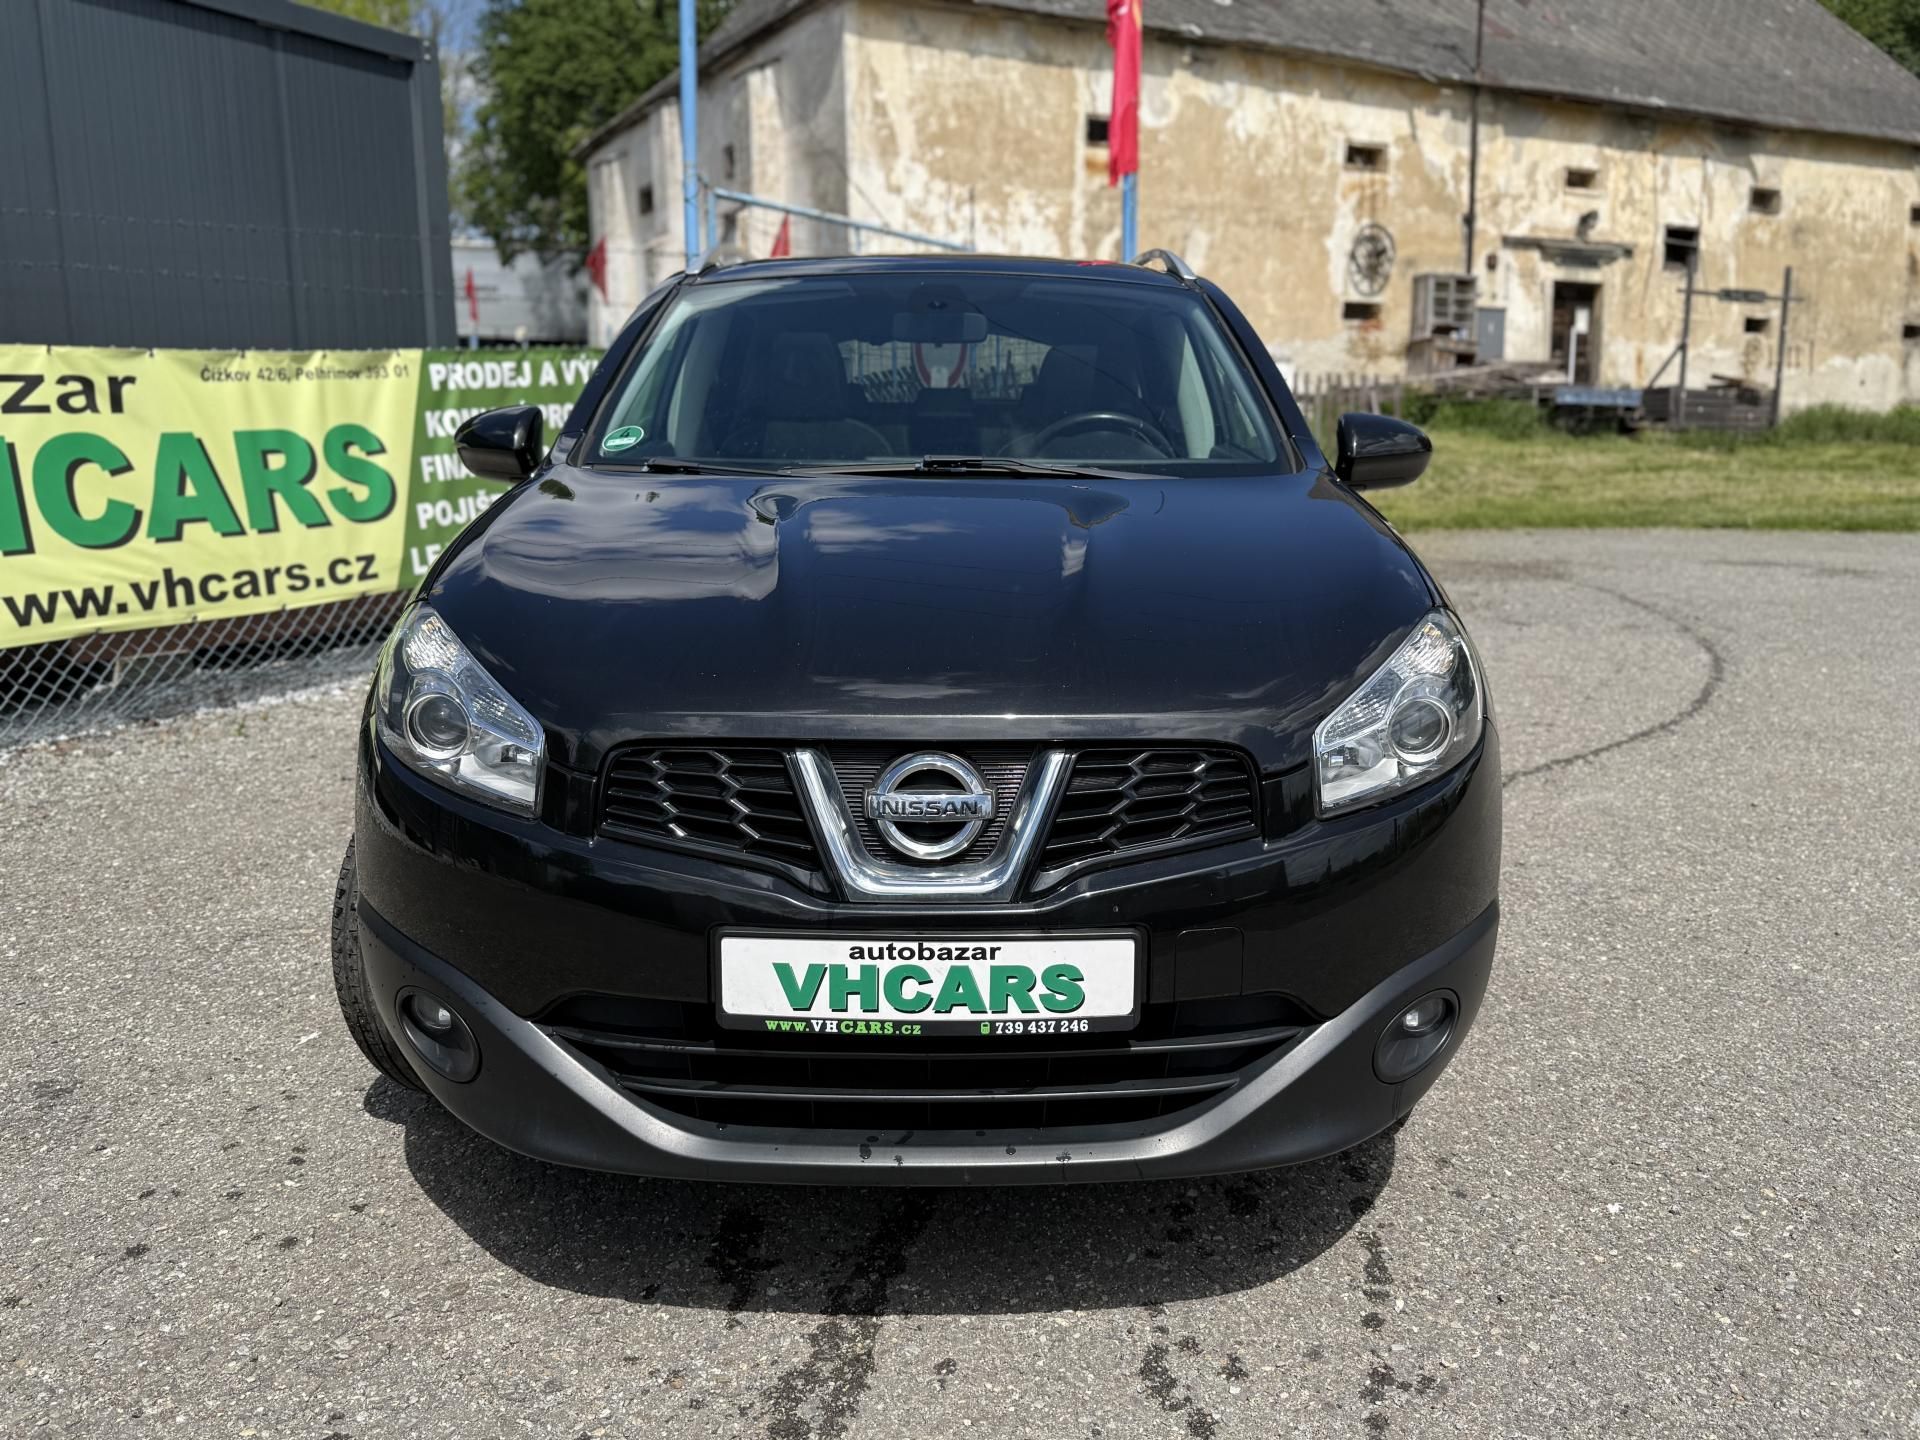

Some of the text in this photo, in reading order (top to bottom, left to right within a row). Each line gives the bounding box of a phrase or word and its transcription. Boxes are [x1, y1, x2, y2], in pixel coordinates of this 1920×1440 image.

[392, 363, 409, 379] 01
[428, 353, 600, 391] PRODEJ A VÝ
[881, 799, 978, 817] NISSAN
[849, 942, 1002, 961] autobazar
[772, 962, 1086, 1015] VHCARS
[995, 1021, 1024, 1034] 739
[1027, 1020, 1056, 1033] 437
[1060, 1019, 1089, 1033] 246
